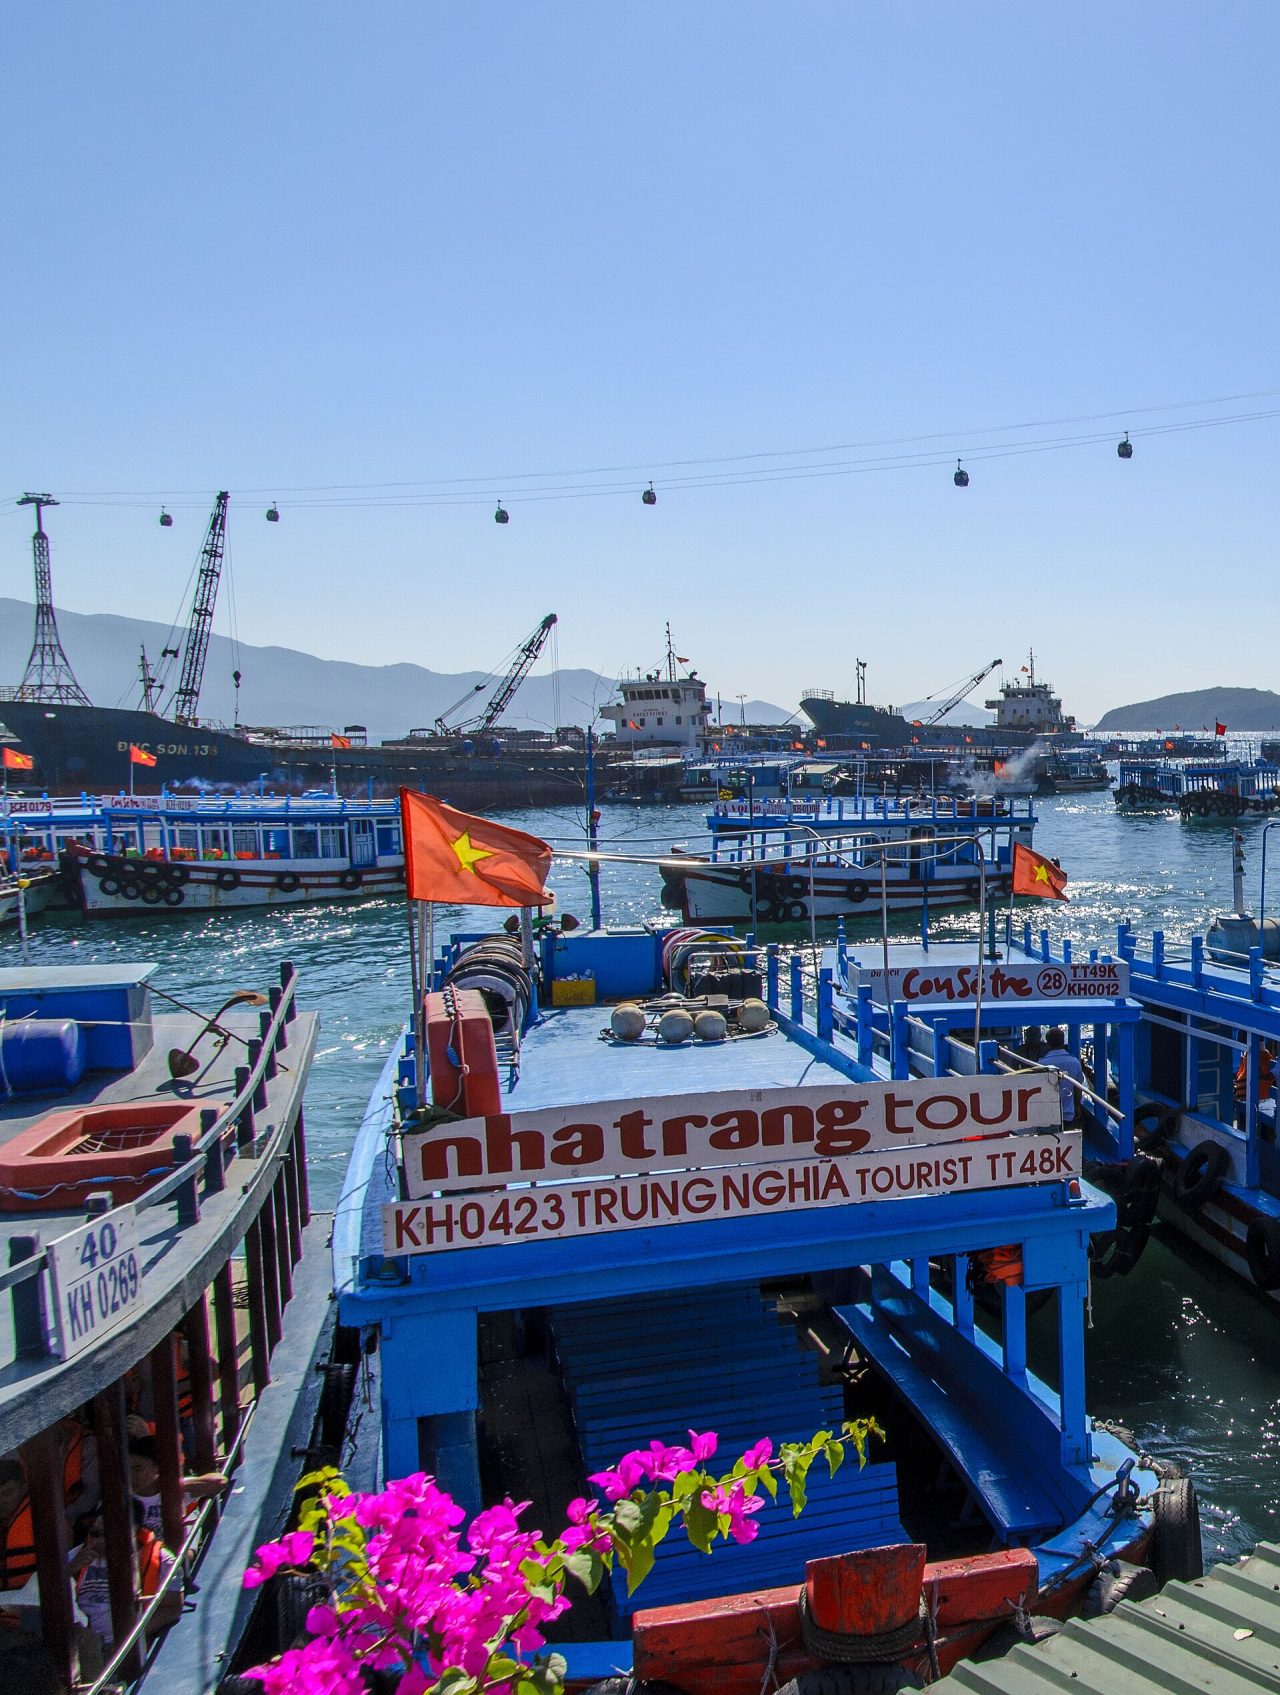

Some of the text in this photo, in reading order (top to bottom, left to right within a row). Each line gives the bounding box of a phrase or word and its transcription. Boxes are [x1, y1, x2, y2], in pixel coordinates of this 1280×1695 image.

[1042, 972, 1063, 991] 28
[1067, 983, 1120, 997] KH0012
[884, 1086, 1042, 1135] tour
[855, 1156, 973, 1196] TOURIST
[81, 1222, 117, 1269] 40
